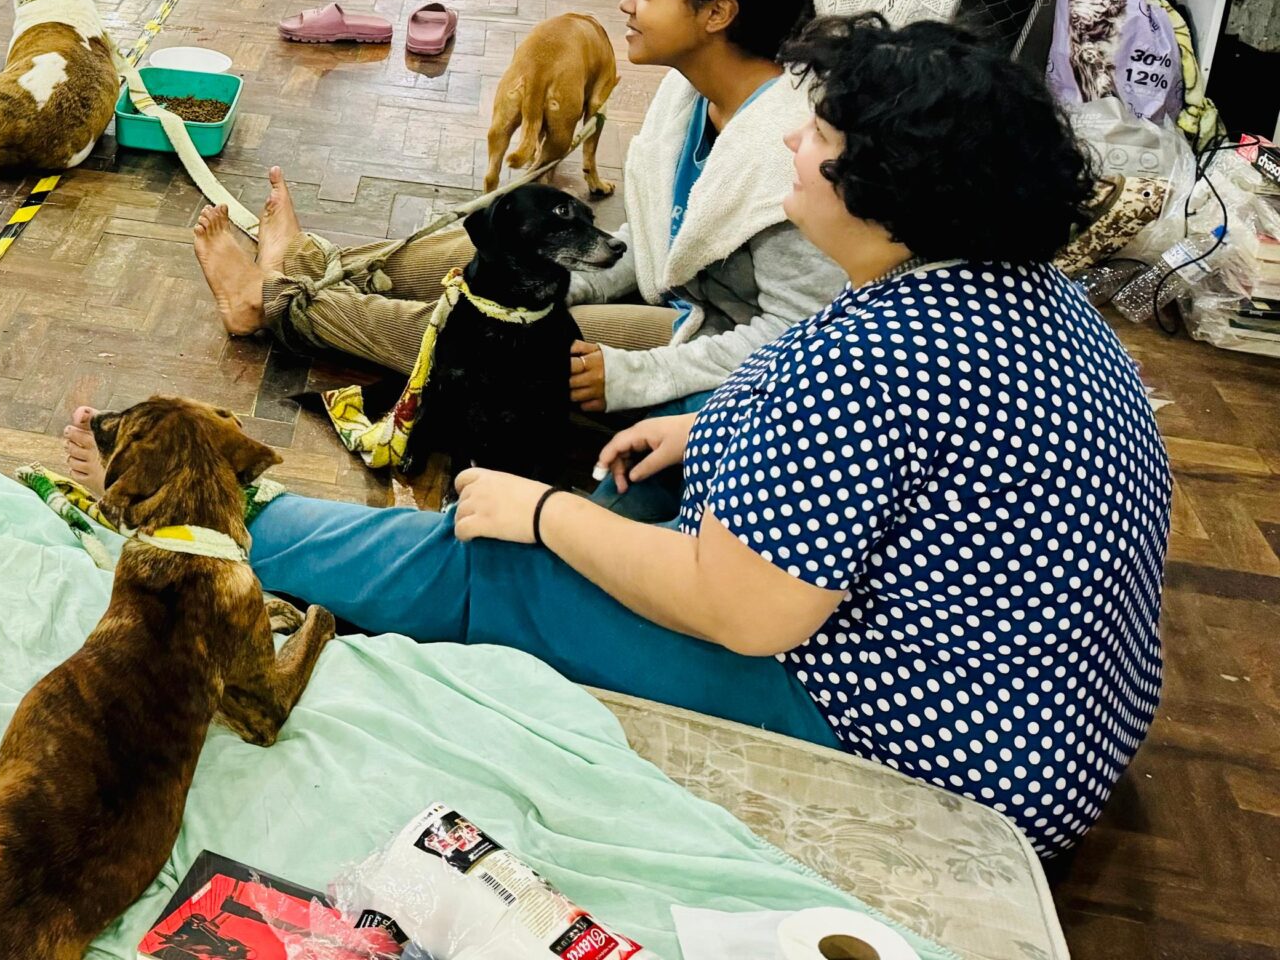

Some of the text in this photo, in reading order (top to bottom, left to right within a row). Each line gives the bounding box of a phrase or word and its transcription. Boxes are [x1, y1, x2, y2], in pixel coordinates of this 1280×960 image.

[1131, 50, 1171, 68] 30%
[1125, 68, 1168, 90] 12%
[566, 928, 609, 960] Clara
